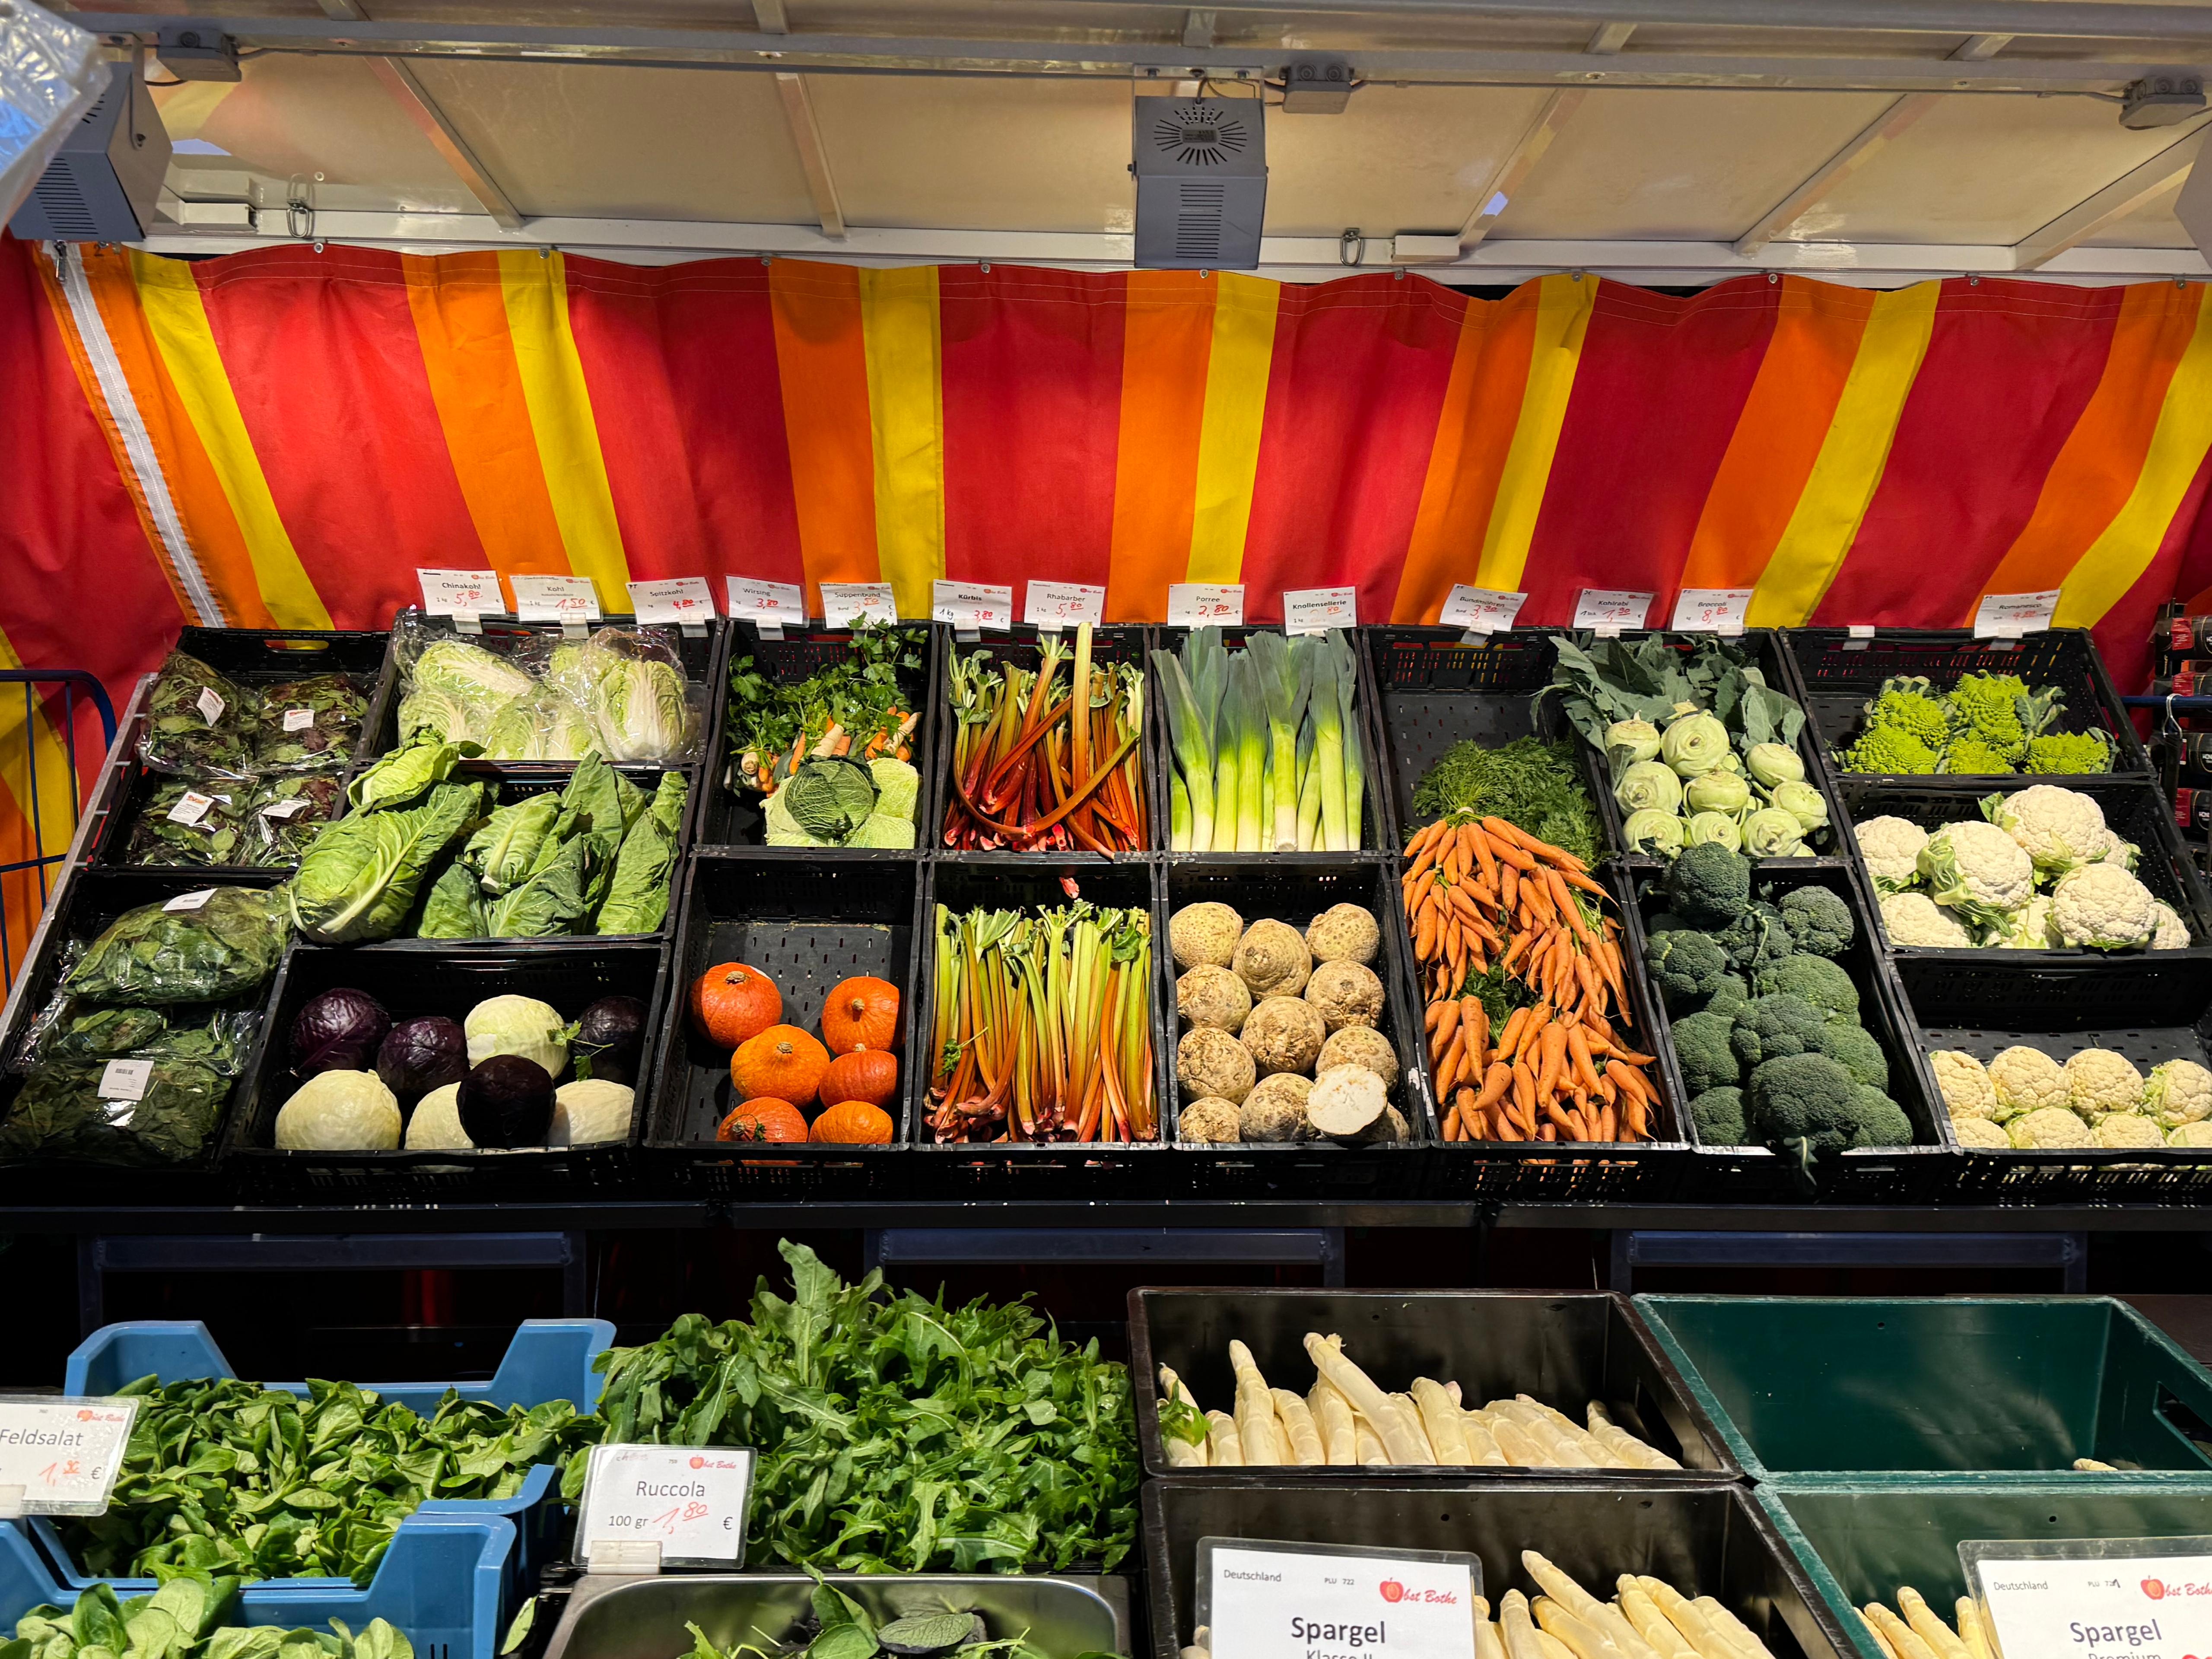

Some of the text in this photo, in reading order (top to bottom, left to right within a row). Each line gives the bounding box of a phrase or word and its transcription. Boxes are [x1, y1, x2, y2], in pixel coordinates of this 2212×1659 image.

[1047, 594, 1085, 602] Rhabarber
[1293, 600, 1347, 610] Knollensellerie
[1460, 597, 1505, 607] Bundmöhren
[0, 1429, 83, 1446] Feldsalat
[91, 1467, 102, 1480] €
[636, 1481, 705, 1497] Ruccola
[608, 1516, 631, 1526] 100
[635, 1519, 648, 1529] gr
[723, 1517, 733, 1530] €
[1224, 1570, 1281, 1582] Deutschland
[1425, 1589, 1458, 1605] Bothe
[1994, 1580, 2048, 1591] Deutschland
[1291, 1617, 1385, 1646] Spargel
[2070, 1619, 2162, 1646] Spargel
